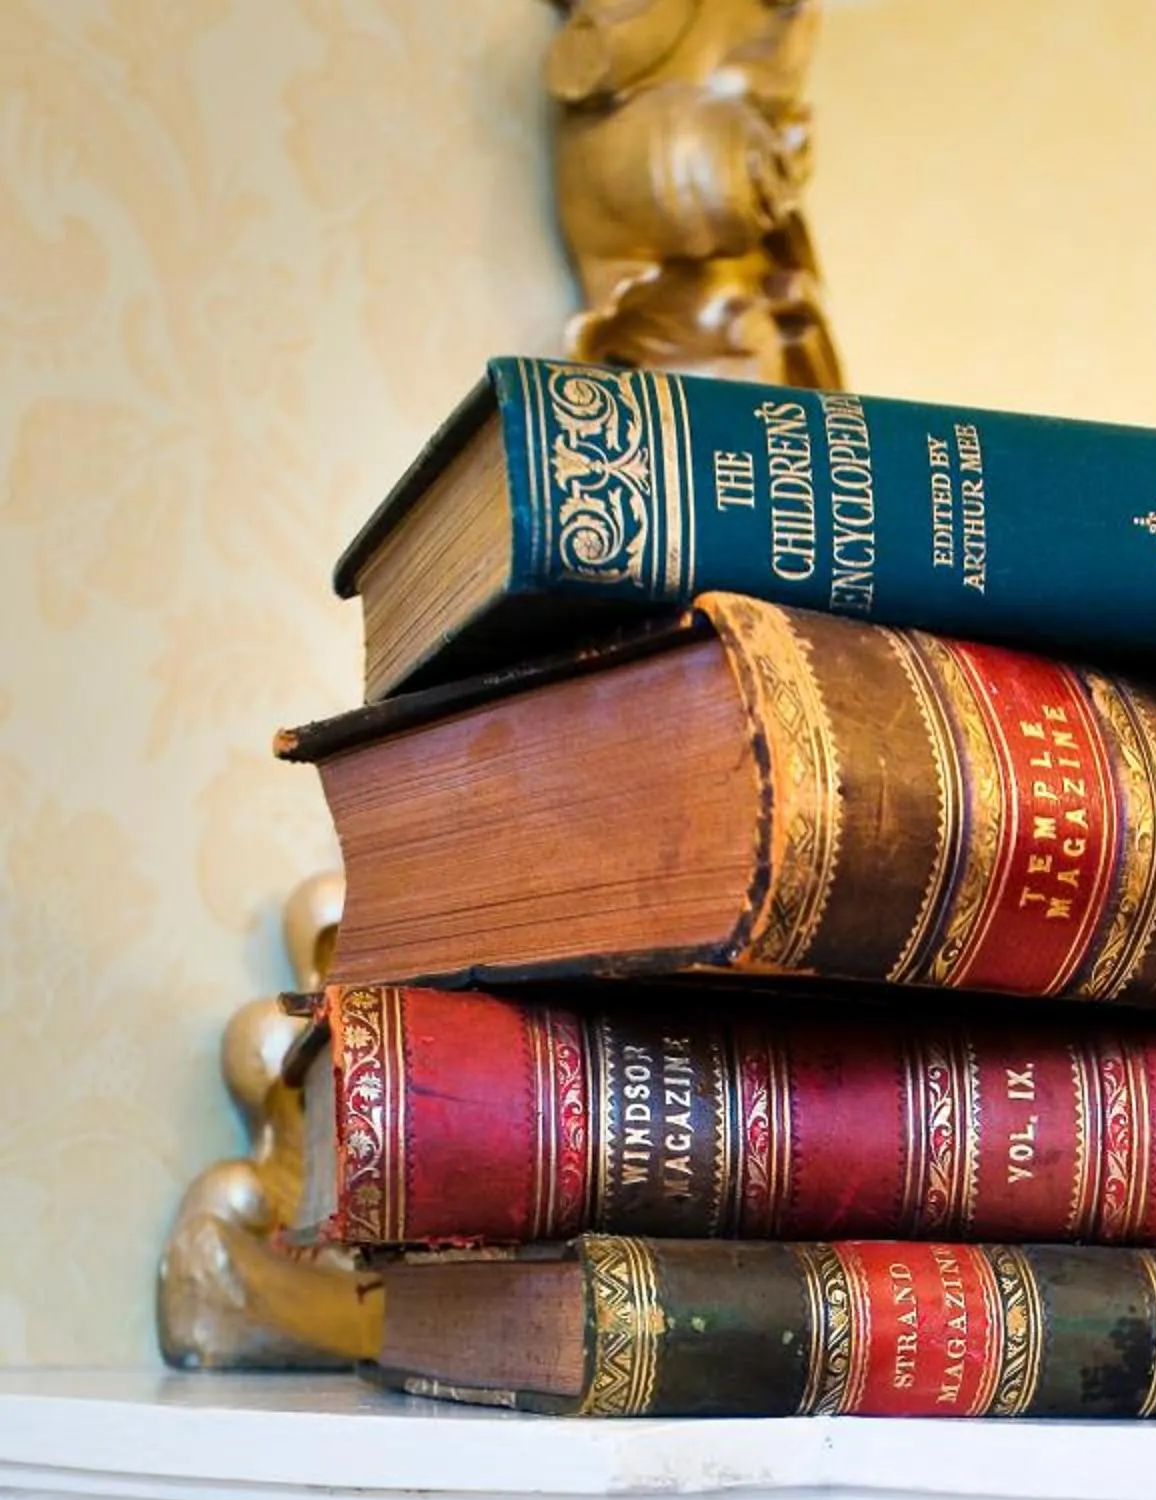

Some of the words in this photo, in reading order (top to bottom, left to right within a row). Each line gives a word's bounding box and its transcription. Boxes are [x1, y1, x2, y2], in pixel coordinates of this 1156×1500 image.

[714, 449, 755, 511] THE
[927, 432, 950, 469] BY
[955, 422, 983, 475] MEE
[931, 472, 955, 569] EDITED
[962, 478, 987, 595] ARTHUR
[1019, 720, 1058, 908] TEMPLE
[1042, 704, 1089, 918] MAGAZINE
[621, 1045, 654, 1185] WINDSOR
[1006, 1063, 1035, 1100] IX.
[1008, 1115, 1038, 1183] VOL.
[888, 1262, 918, 1389] STRAND
[930, 1244, 968, 1405] MAGAZINE
